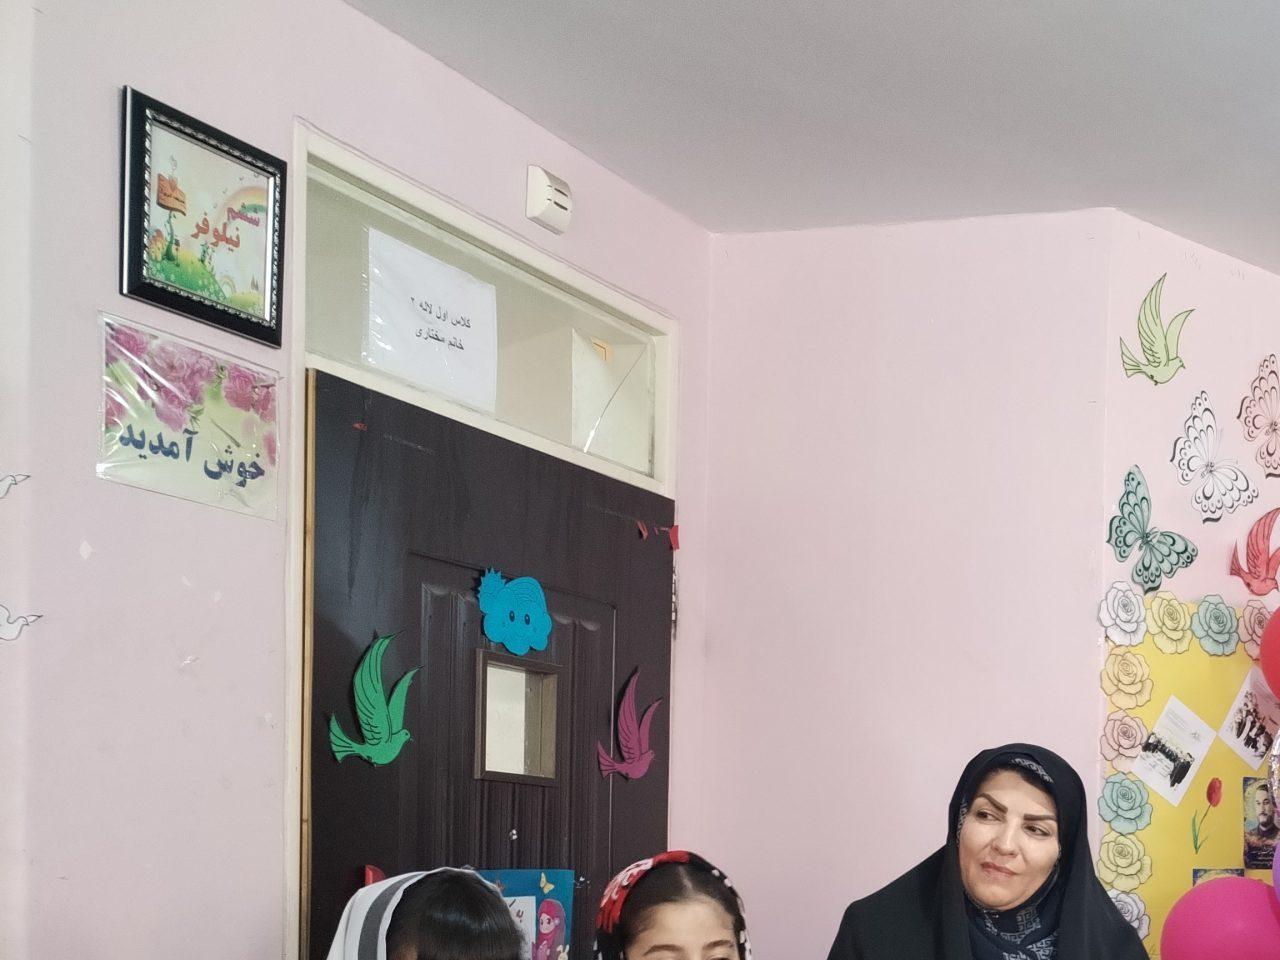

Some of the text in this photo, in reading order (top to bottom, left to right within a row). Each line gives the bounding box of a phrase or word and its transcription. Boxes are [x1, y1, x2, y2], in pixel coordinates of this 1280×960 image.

[190, 211, 241, 252] نیلوفر
[435, 306, 448, 322] اول
[450, 315, 471, 329] کلاس
[118, 423, 265, 488] خوش آمدید
